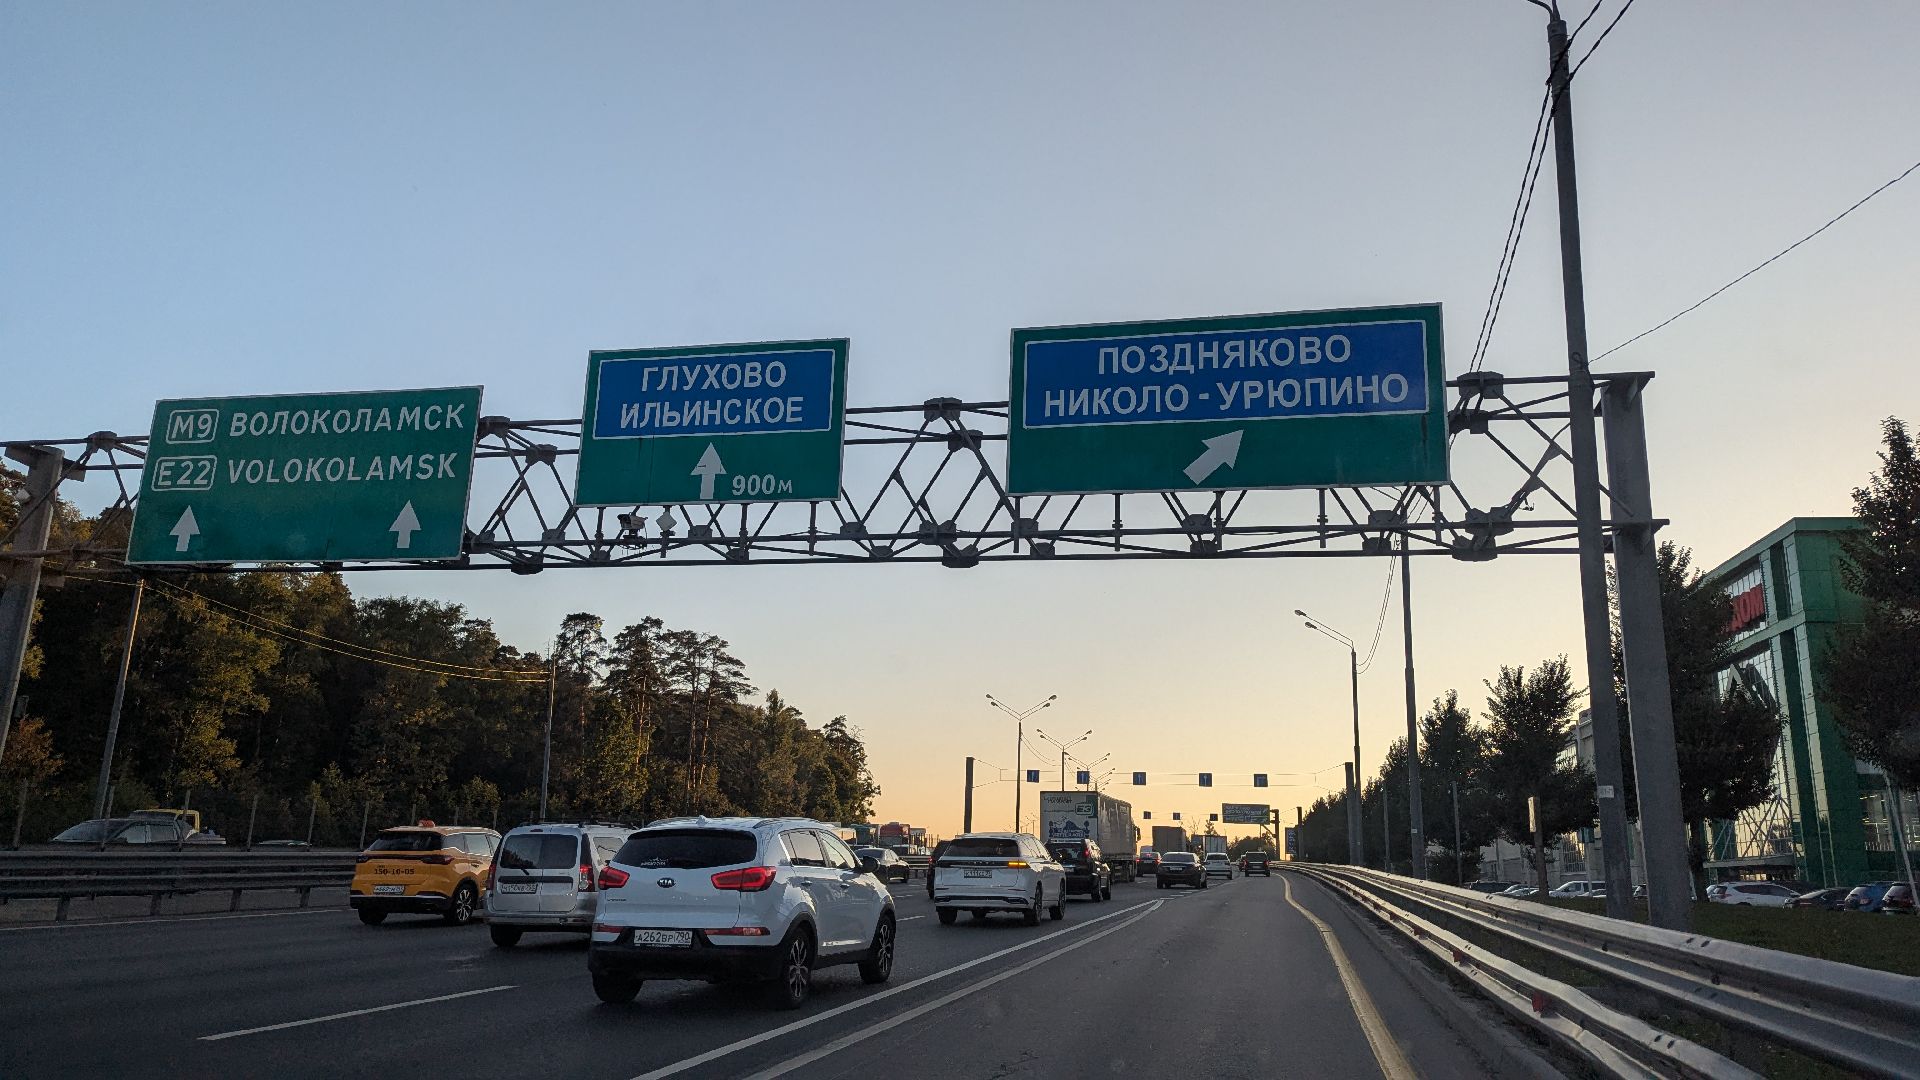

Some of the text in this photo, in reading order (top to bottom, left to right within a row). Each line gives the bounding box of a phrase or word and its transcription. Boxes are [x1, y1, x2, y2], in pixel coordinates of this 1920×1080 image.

[1098, 334, 1351, 375] ПОЗДНЯКОВО
[642, 361, 787, 392] ГЛУХОВО
[171, 403, 465, 439] М9 ВОЛОКОЛАМСК
[620, 396, 804, 429] ИЛЬИНСКОЕ
[158, 452, 458, 486] E22 VOLOKOLAMSK
